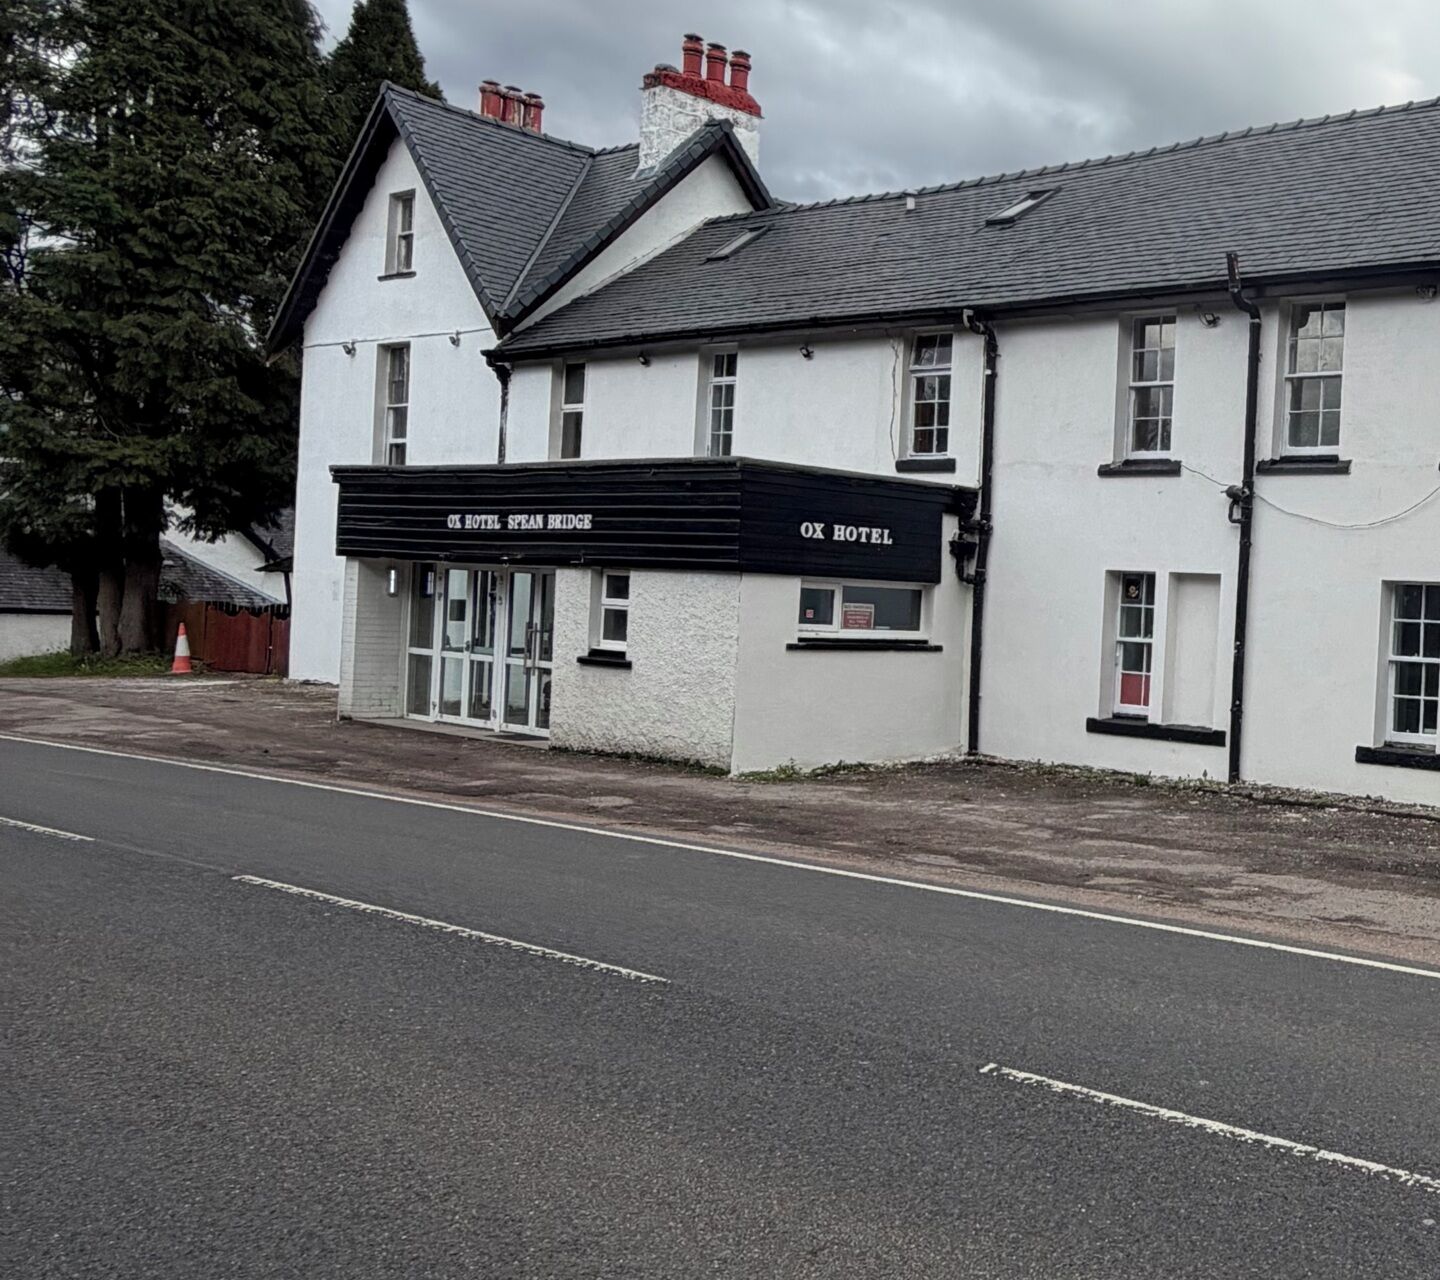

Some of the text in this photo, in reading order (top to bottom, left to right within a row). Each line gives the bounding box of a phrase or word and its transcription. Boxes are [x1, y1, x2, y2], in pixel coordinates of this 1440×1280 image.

[447, 514, 593, 529] OX HOTEL SPEAN BRIDGE
[800, 522, 893, 545] OX HOTEL
